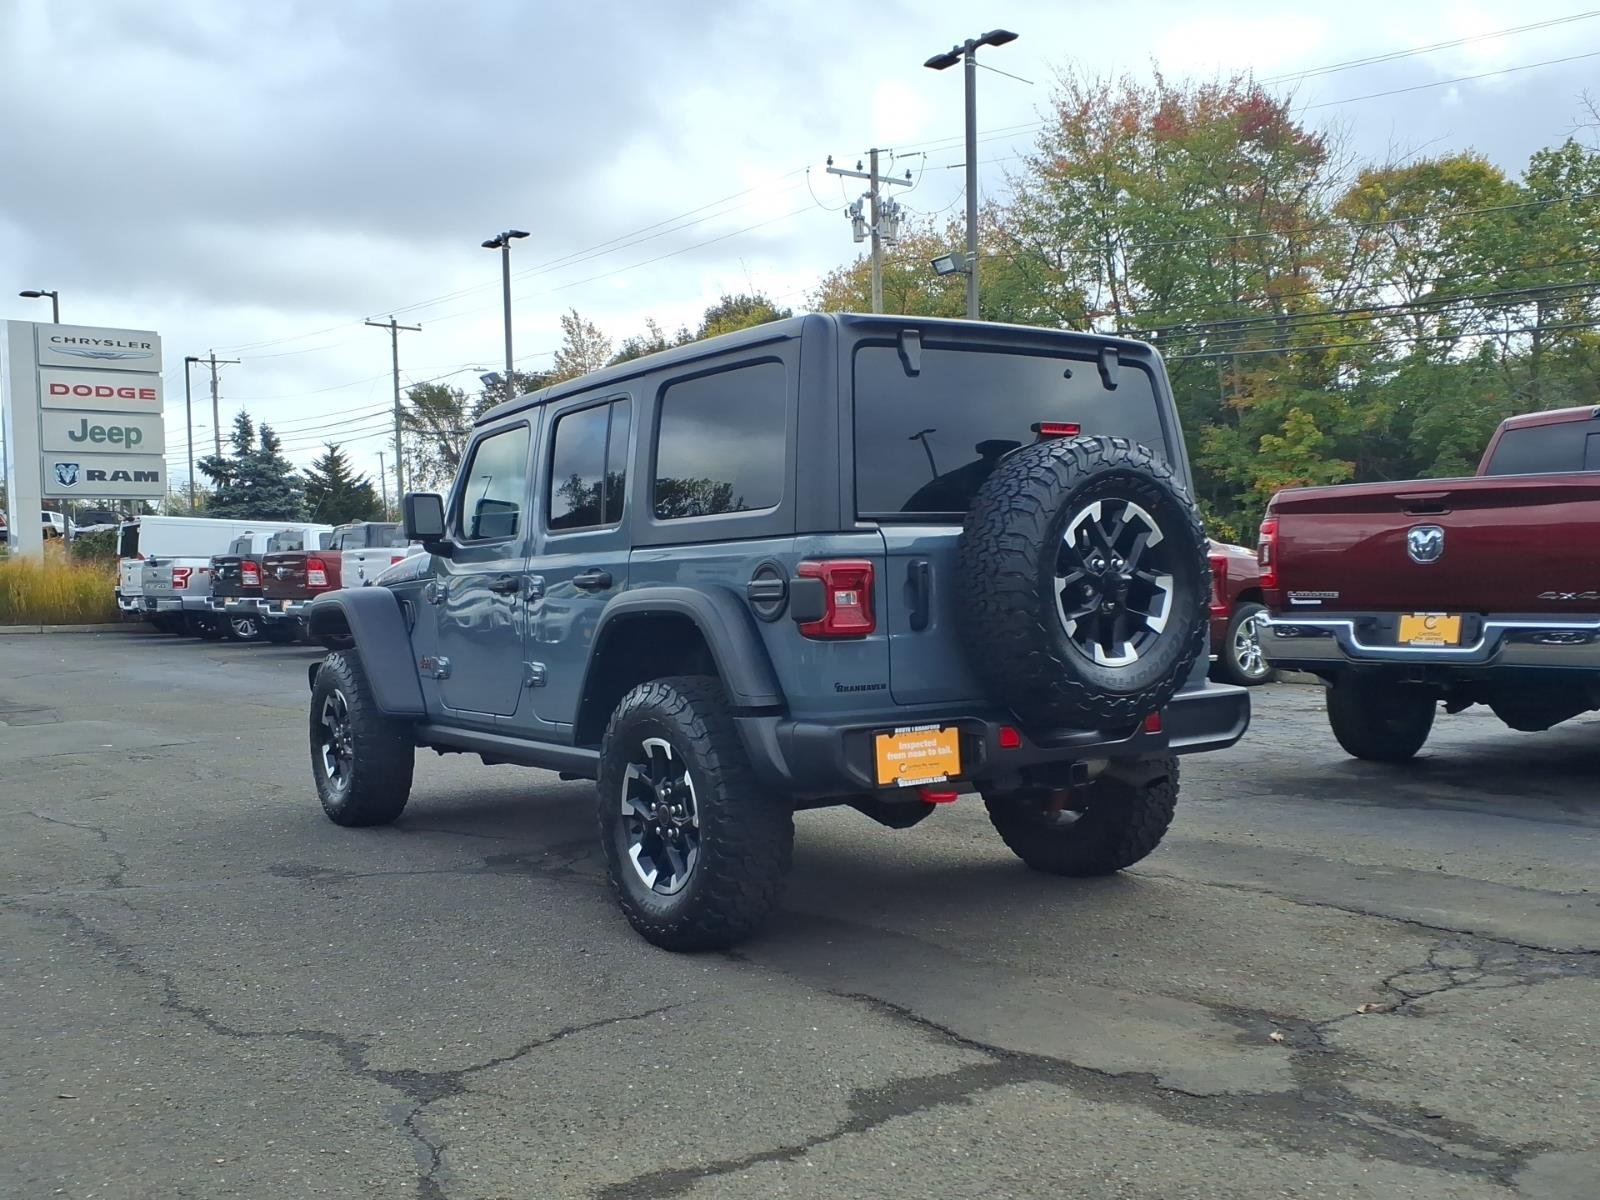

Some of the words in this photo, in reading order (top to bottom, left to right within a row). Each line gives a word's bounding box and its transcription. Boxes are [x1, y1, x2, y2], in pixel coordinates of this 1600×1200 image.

[50, 335, 152, 350] CHRYSLER
[50, 383, 156, 400] DODGE
[68, 418, 142, 449] Jeep
[86, 469, 159, 482] RAM
[899, 738, 937, 750] Inspected
[887, 751, 906, 760] from
[908, 749, 926, 758] nose
[928, 748, 937, 756] to
